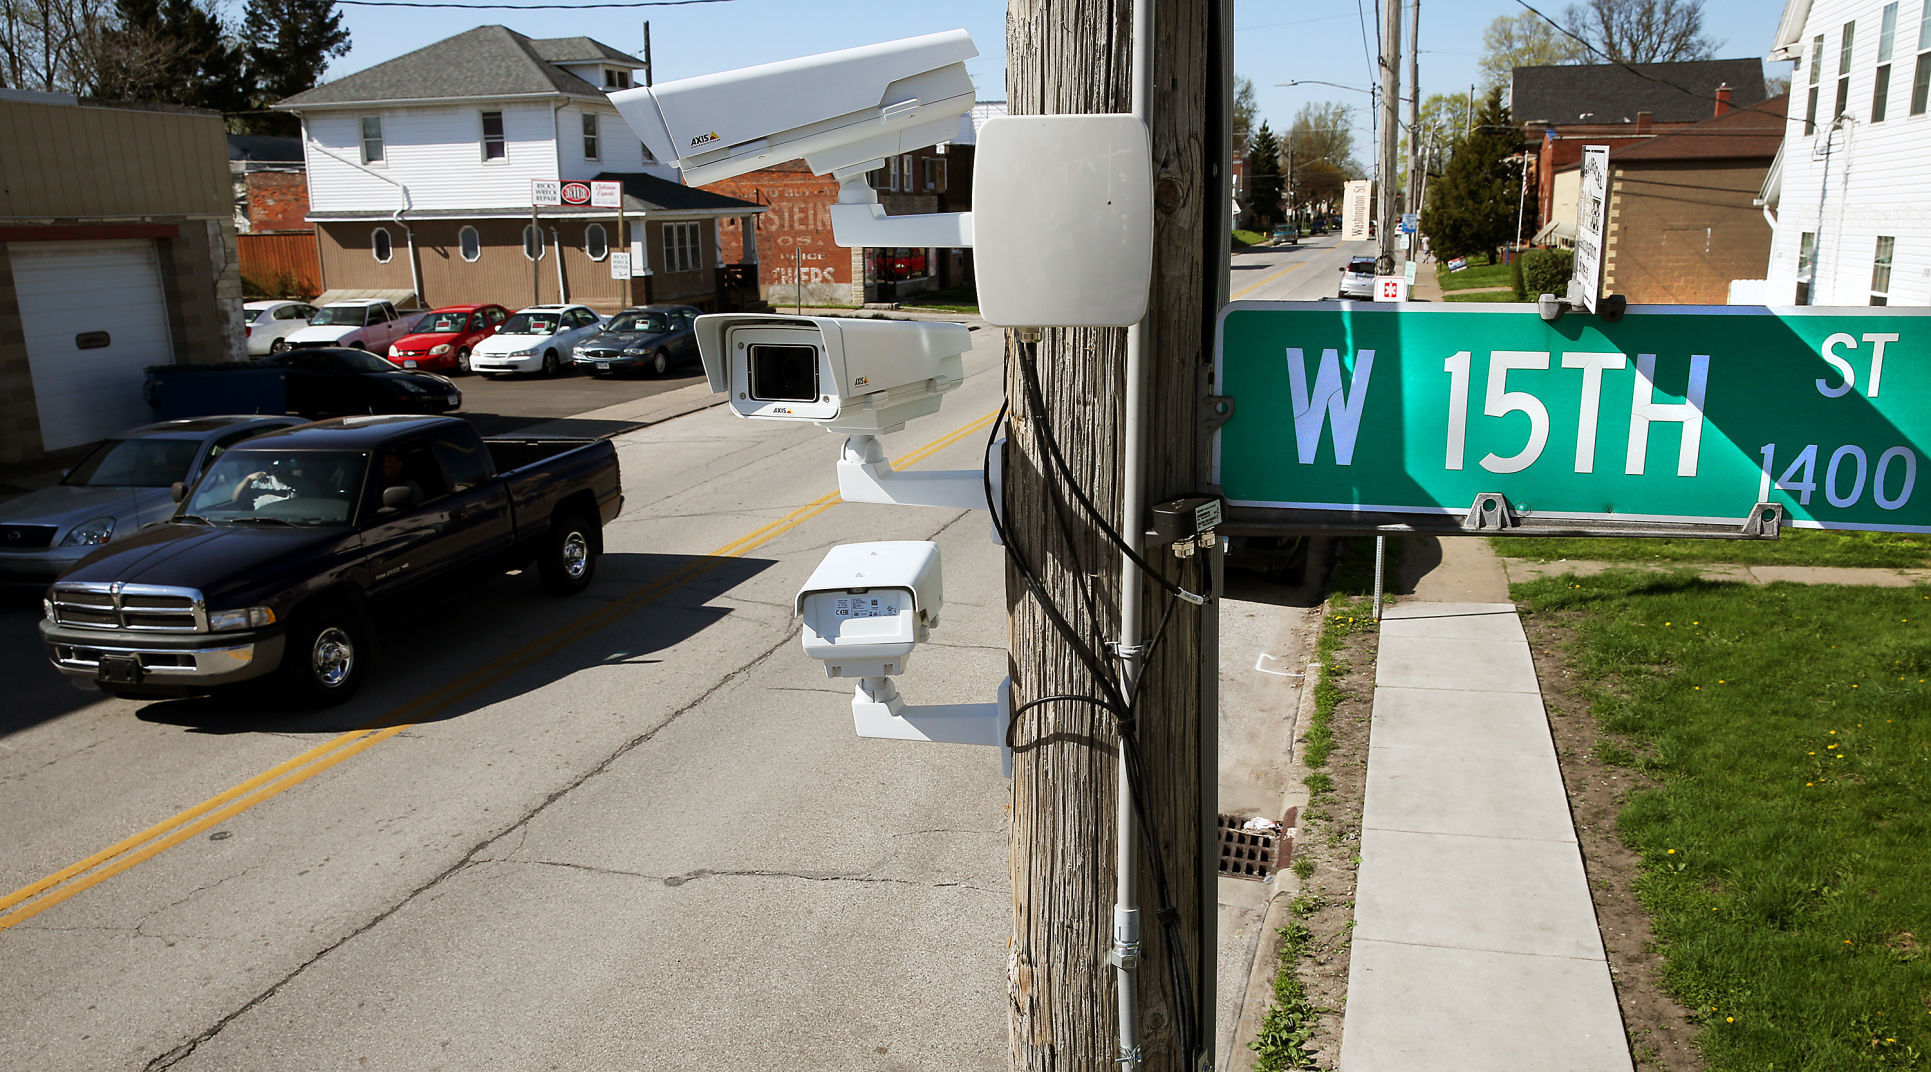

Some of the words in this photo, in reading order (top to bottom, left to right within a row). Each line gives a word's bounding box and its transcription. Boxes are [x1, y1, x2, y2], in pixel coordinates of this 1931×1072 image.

[690, 133, 710, 147] AXIS
[1352, 195, 1366, 237] Washington
[1285, 347, 1376, 466] W
[1444, 350, 1710, 478] 15TH
[1815, 332, 1900, 398] ST
[1758, 442, 1918, 511] 1400
